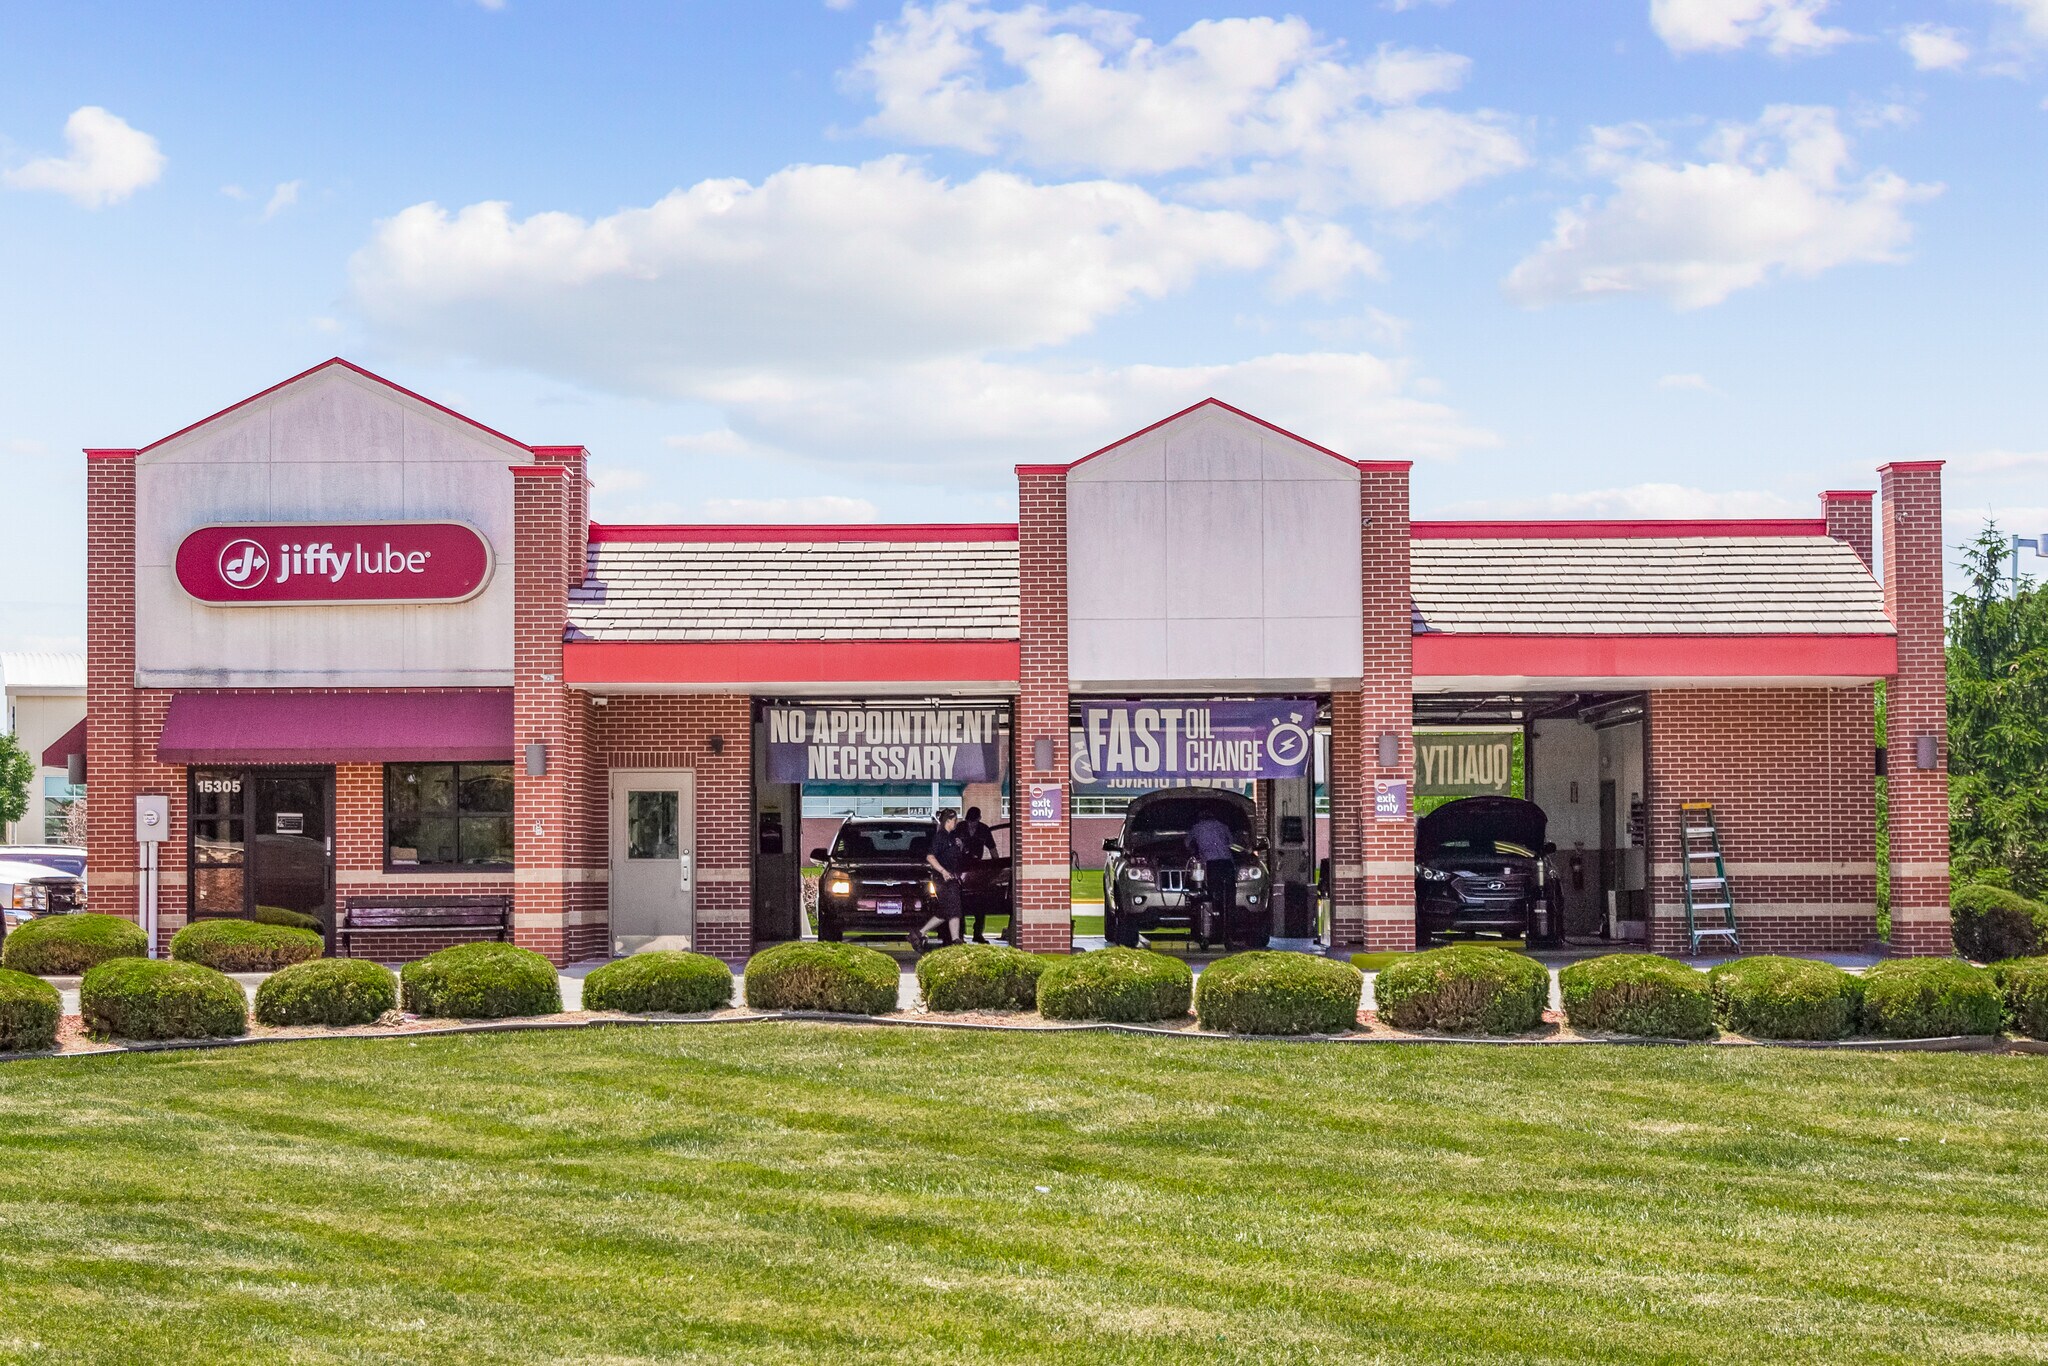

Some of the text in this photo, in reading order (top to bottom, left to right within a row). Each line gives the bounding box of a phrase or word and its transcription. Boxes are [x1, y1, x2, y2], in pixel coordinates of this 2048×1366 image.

[276, 544, 352, 583] jiffy
[770, 709, 996, 745] NO APPOINTMENT
[1088, 708, 1183, 772] FAST
[1185, 708, 1215, 740] OIL
[808, 745, 958, 780] NECESSARY
[1185, 740, 1264, 772] CHANGE
[197, 780, 241, 793] 15305
[1031, 797, 1051, 808] exit
[1376, 793, 1396, 803] exit
[1031, 807, 1054, 819] only
[1376, 802, 1399, 814] only
